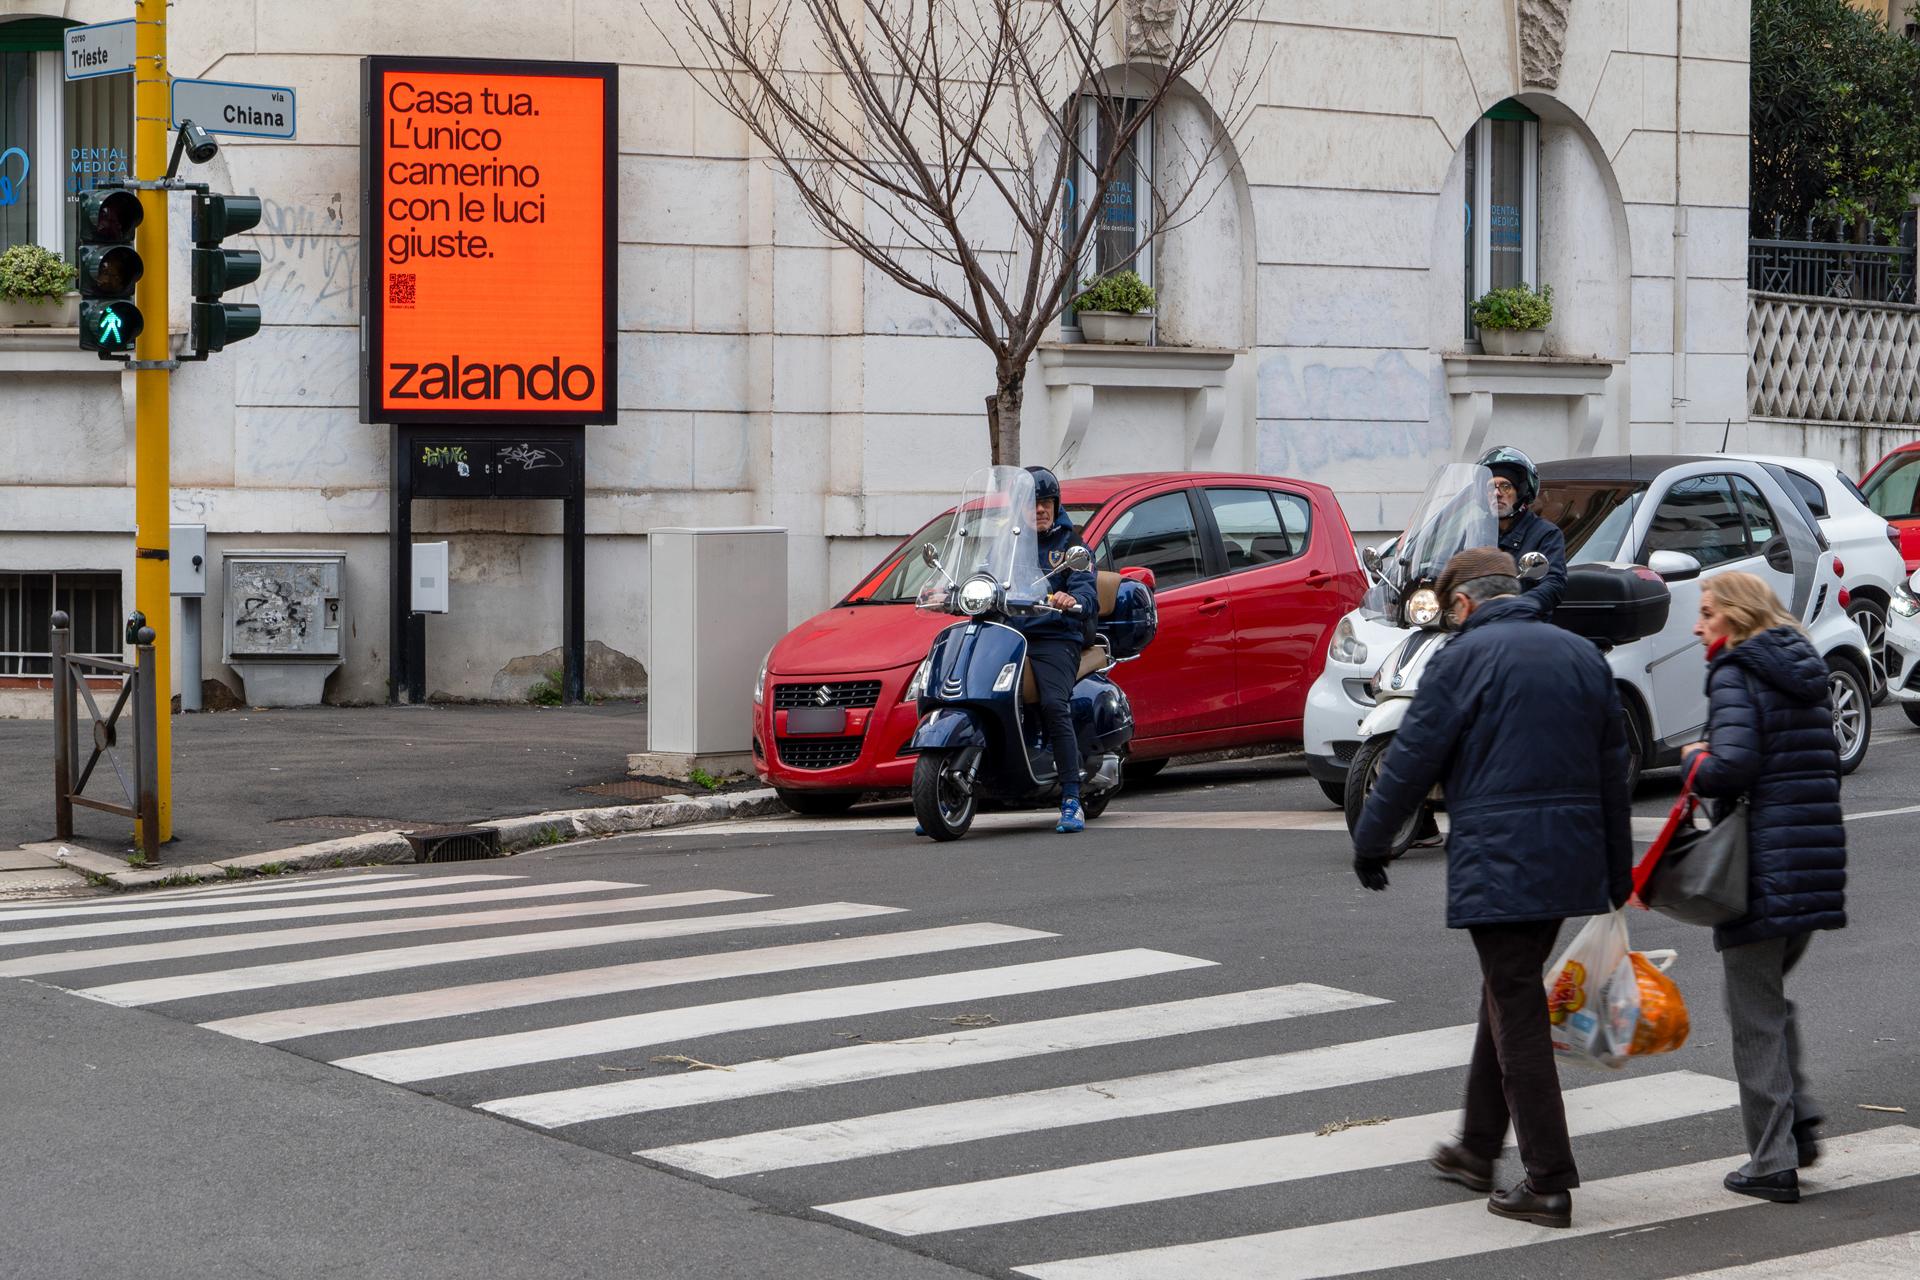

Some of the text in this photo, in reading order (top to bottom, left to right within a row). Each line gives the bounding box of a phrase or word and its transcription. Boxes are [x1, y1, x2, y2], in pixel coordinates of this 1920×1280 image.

[71, 34, 86, 44] corso
[72, 46, 108, 68] Trieste
[271, 92, 285, 103] via
[389, 81, 540, 117] Casa tua.
[223, 104, 285, 127] Chiana
[71, 148, 128, 160] DENTAL
[71, 161, 128, 173] MEDICA
[388, 157, 540, 188] camerino
[388, 191, 546, 224] con le luci
[388, 227, 495, 265] giuste.
[389, 354, 596, 402] zalando
